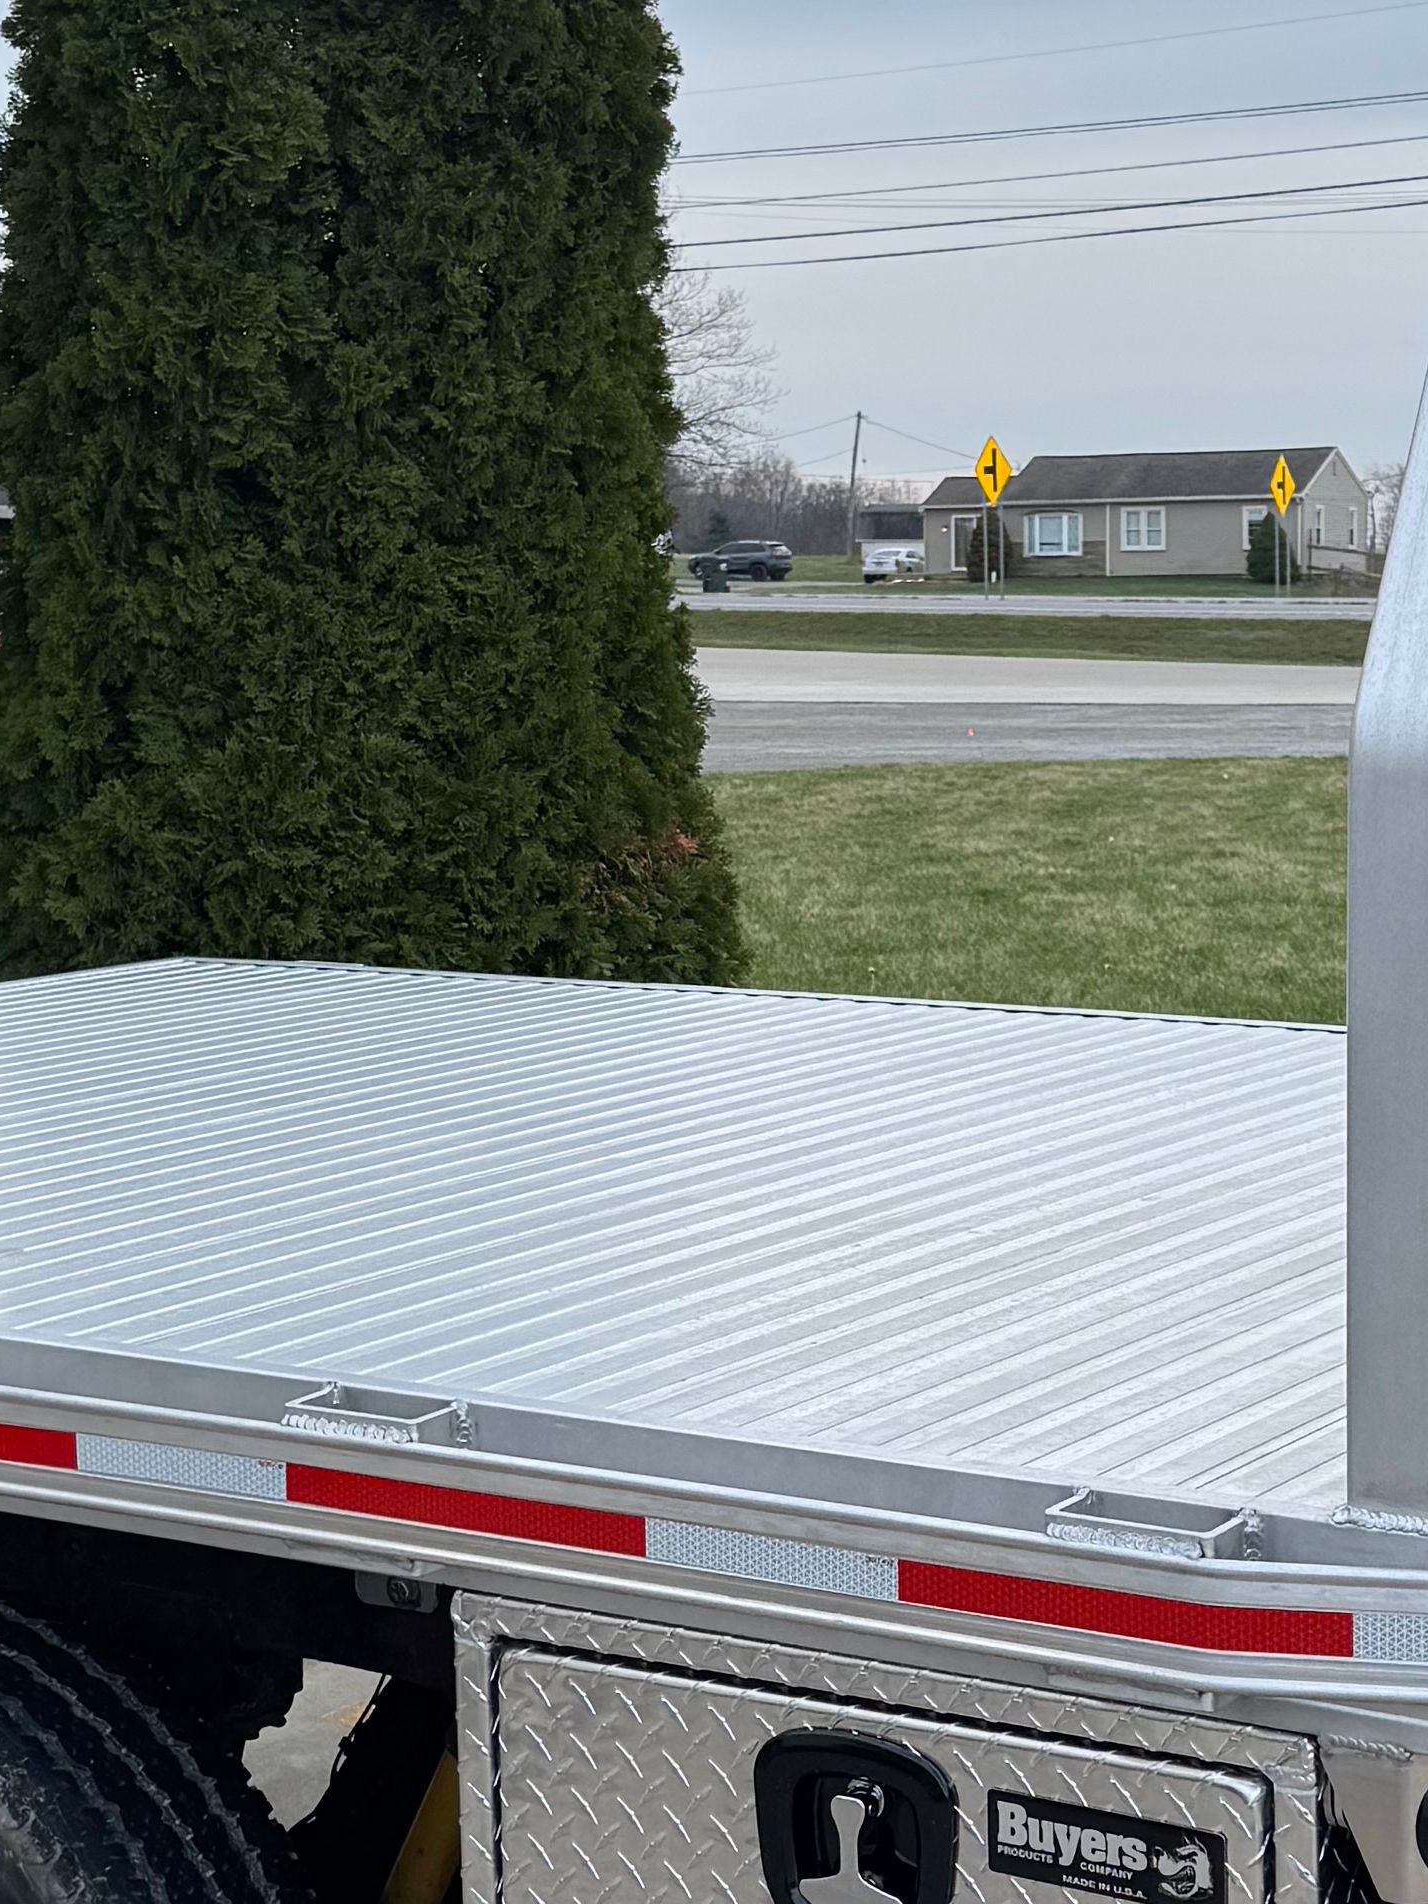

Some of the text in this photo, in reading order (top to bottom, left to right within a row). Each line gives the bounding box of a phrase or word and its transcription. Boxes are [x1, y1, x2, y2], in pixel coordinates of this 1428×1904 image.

[996, 1800, 1148, 1872] Buyers
[996, 1844, 1134, 1881] PRODUCTS COMPANY
[1062, 1874, 1096, 1890] MADE
[1098, 1882, 1111, 1893] IN
